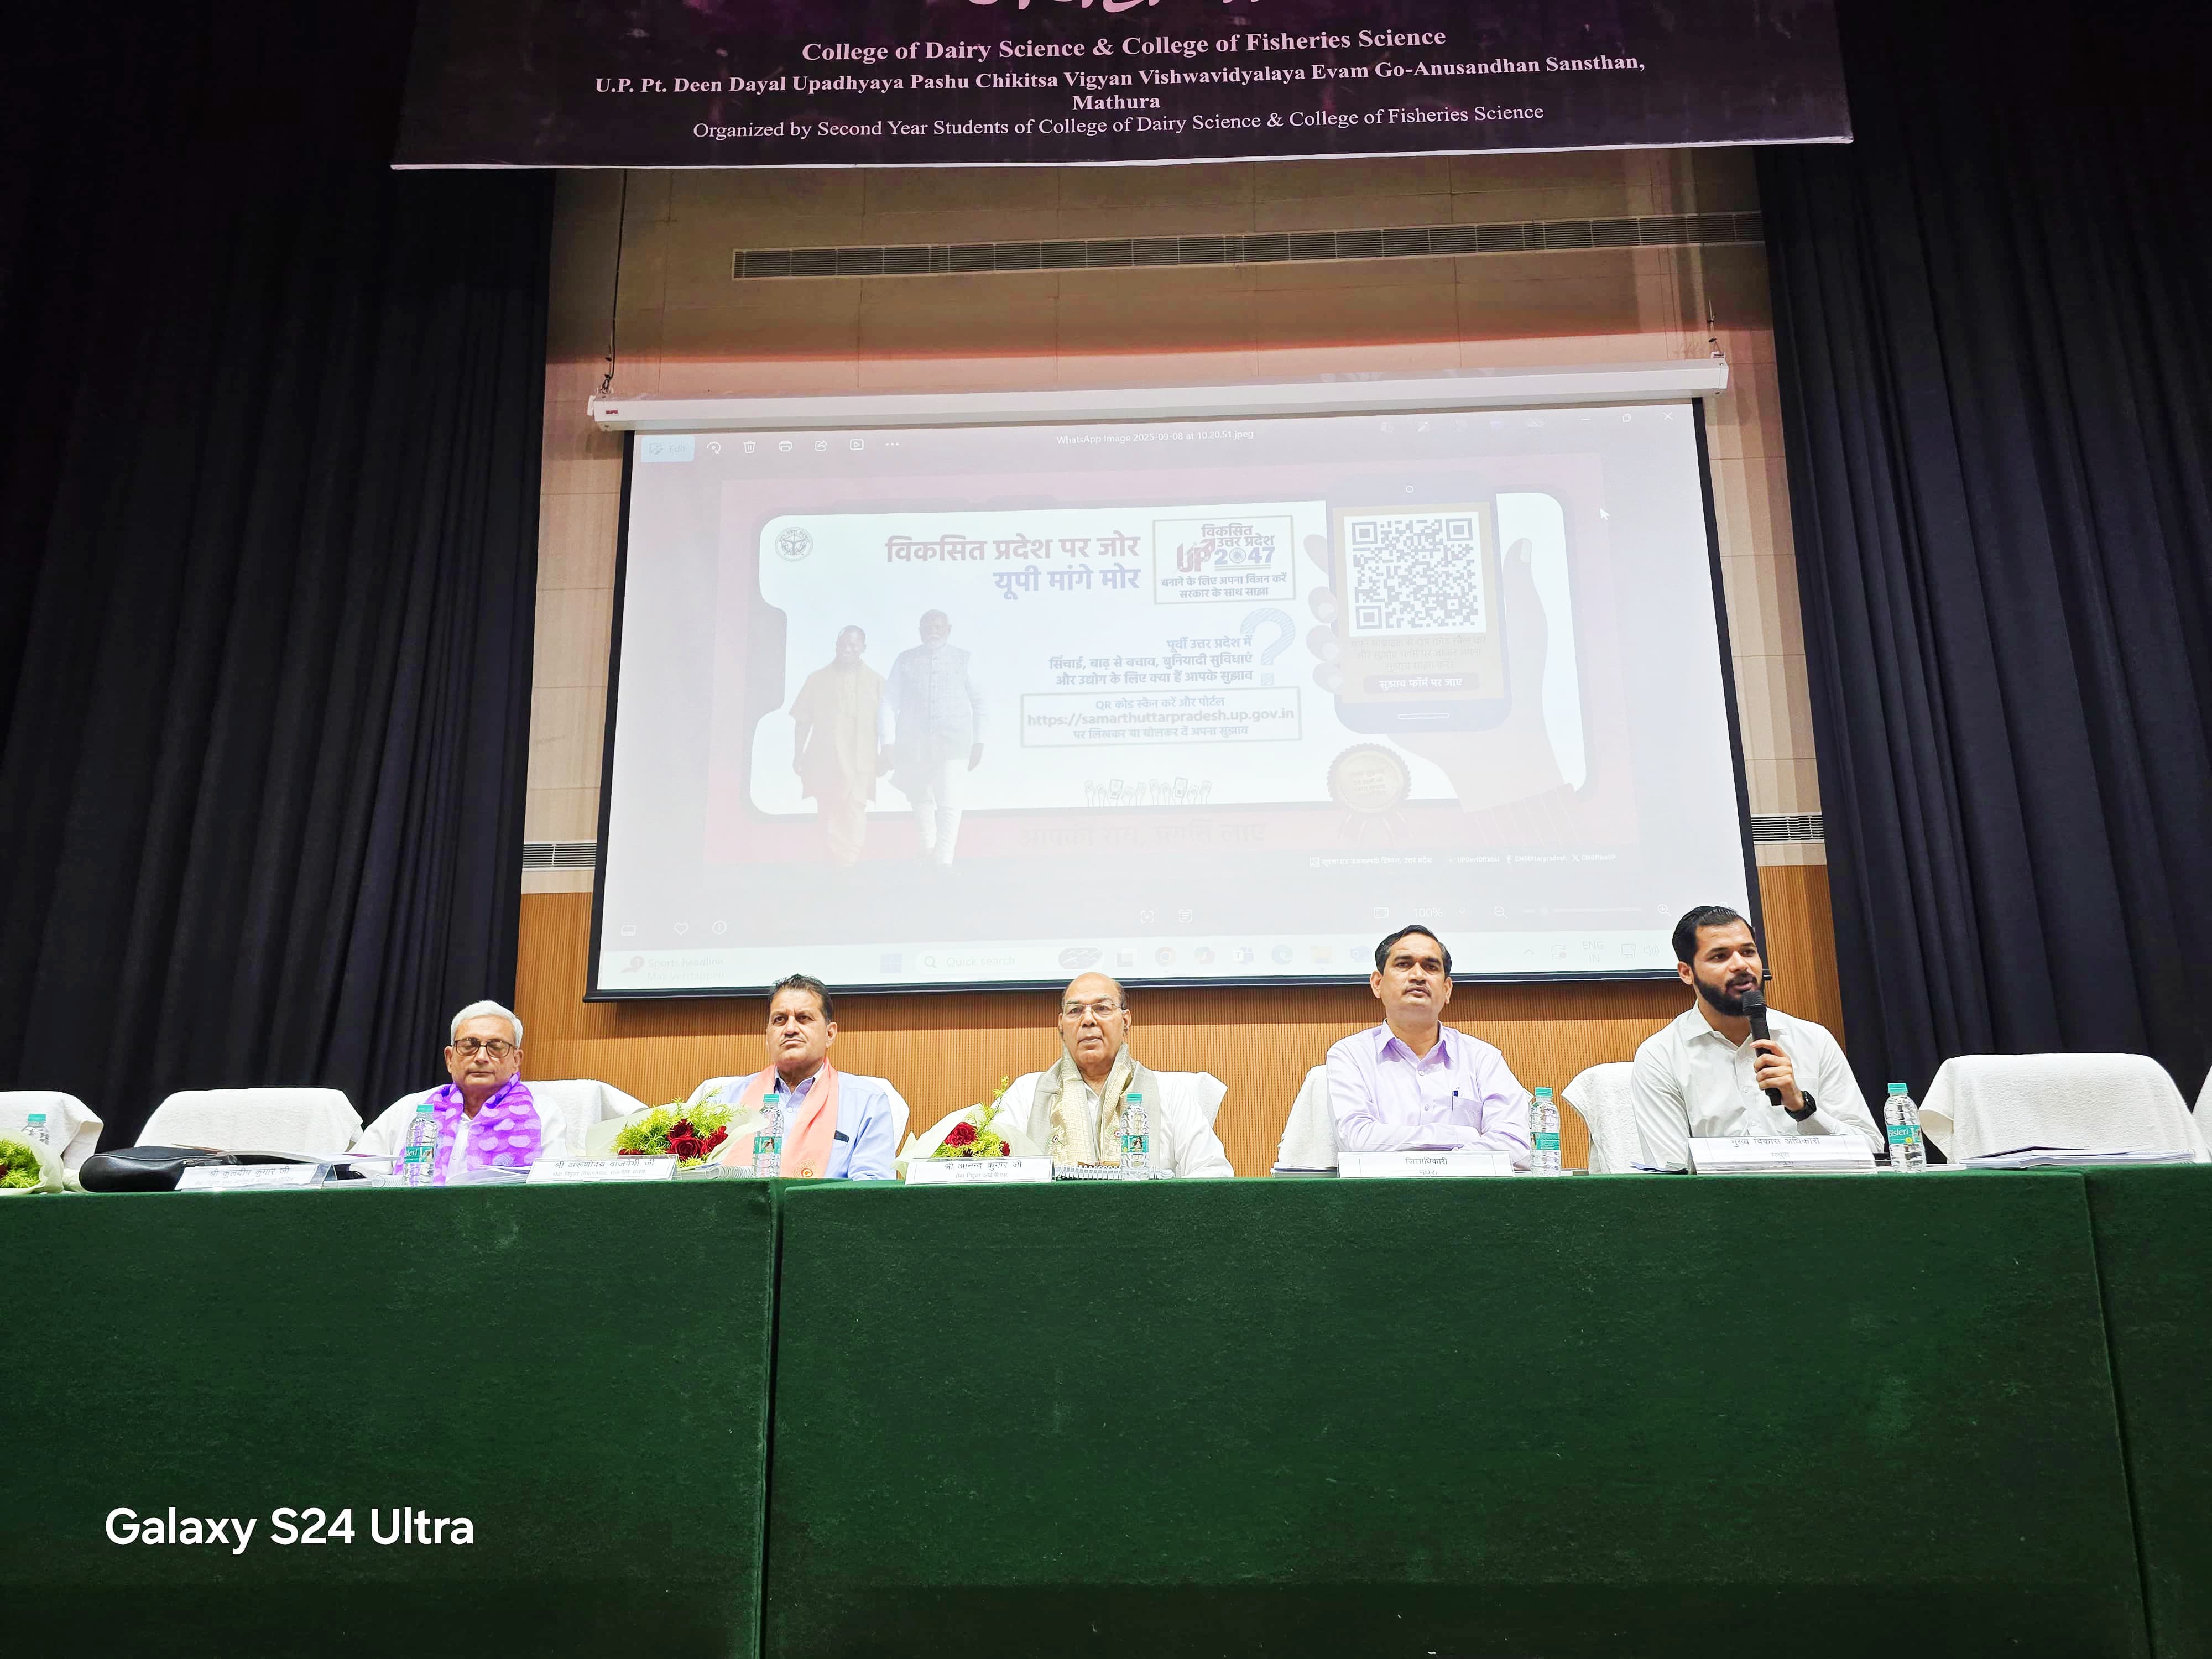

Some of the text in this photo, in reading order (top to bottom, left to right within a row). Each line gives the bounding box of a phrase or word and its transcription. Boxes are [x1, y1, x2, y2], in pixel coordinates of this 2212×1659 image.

[802, 29, 1446, 64] College of Dairy Science & College of Fisheries Science
[597, 55, 1644, 95] U.P. Pt. Deen Dayal Upadhyaya Pashu Chikitsa Vigyan Vishwavidyalaya Evam Go-Anusandhan Sansthan,
[1073, 95, 1160, 110] Mathura
[694, 106, 1543, 140] Organized by Second Year Students of College of Dairy Science & College of Fisheries Science
[1057, 435, 1101, 444] WhatsApp
[1104, 434, 1130, 444] Image
[1186, 431, 1194, 440] at
[1201, 523, 1253, 538] विकसित
[885, 530, 1141, 562] विकसित प्रदेश पर जोर
[1217, 533, 1275, 547] उत्तर प्रदेश
[993, 563, 1141, 600] यूपी मांगे मोर
[1161, 572, 1287, 587] बनाने के लिए अपना विजन करें
[1180, 587, 1269, 598] सरकार के साथ साझा
[1167, 635, 1252, 653] पूर्वी उत्तर प्रदेश में
[1049, 651, 1253, 670] सिंचाई, बाढ़ से बचाव, बुनियादी सुविधाएं
[1056, 669, 1253, 686] और उद्योग के लिए क्या हैं आपके सुझाव
[1379, 680, 1406, 691] सुझाव
[1095, 694, 1225, 710] QR कोड स्कैन करें और पोर्टल
[1027, 708, 1295, 727] https://samarthuttarpradesh.up.gov.in
[1413, 907, 1443, 917] 100%
[1582, 941, 1604, 950] ENG
[648, 959, 678, 969] Sports
[947, 956, 1015, 967] Quick search
[1588, 954, 1600, 963] IN
[554, 1160, 565, 1168] श्री
[644, 1158, 655, 1166] जी
[208, 1167, 219, 1177] श्री
[222, 1167, 252, 1179] कुलदीप
[279, 1166, 291, 1175] जी
